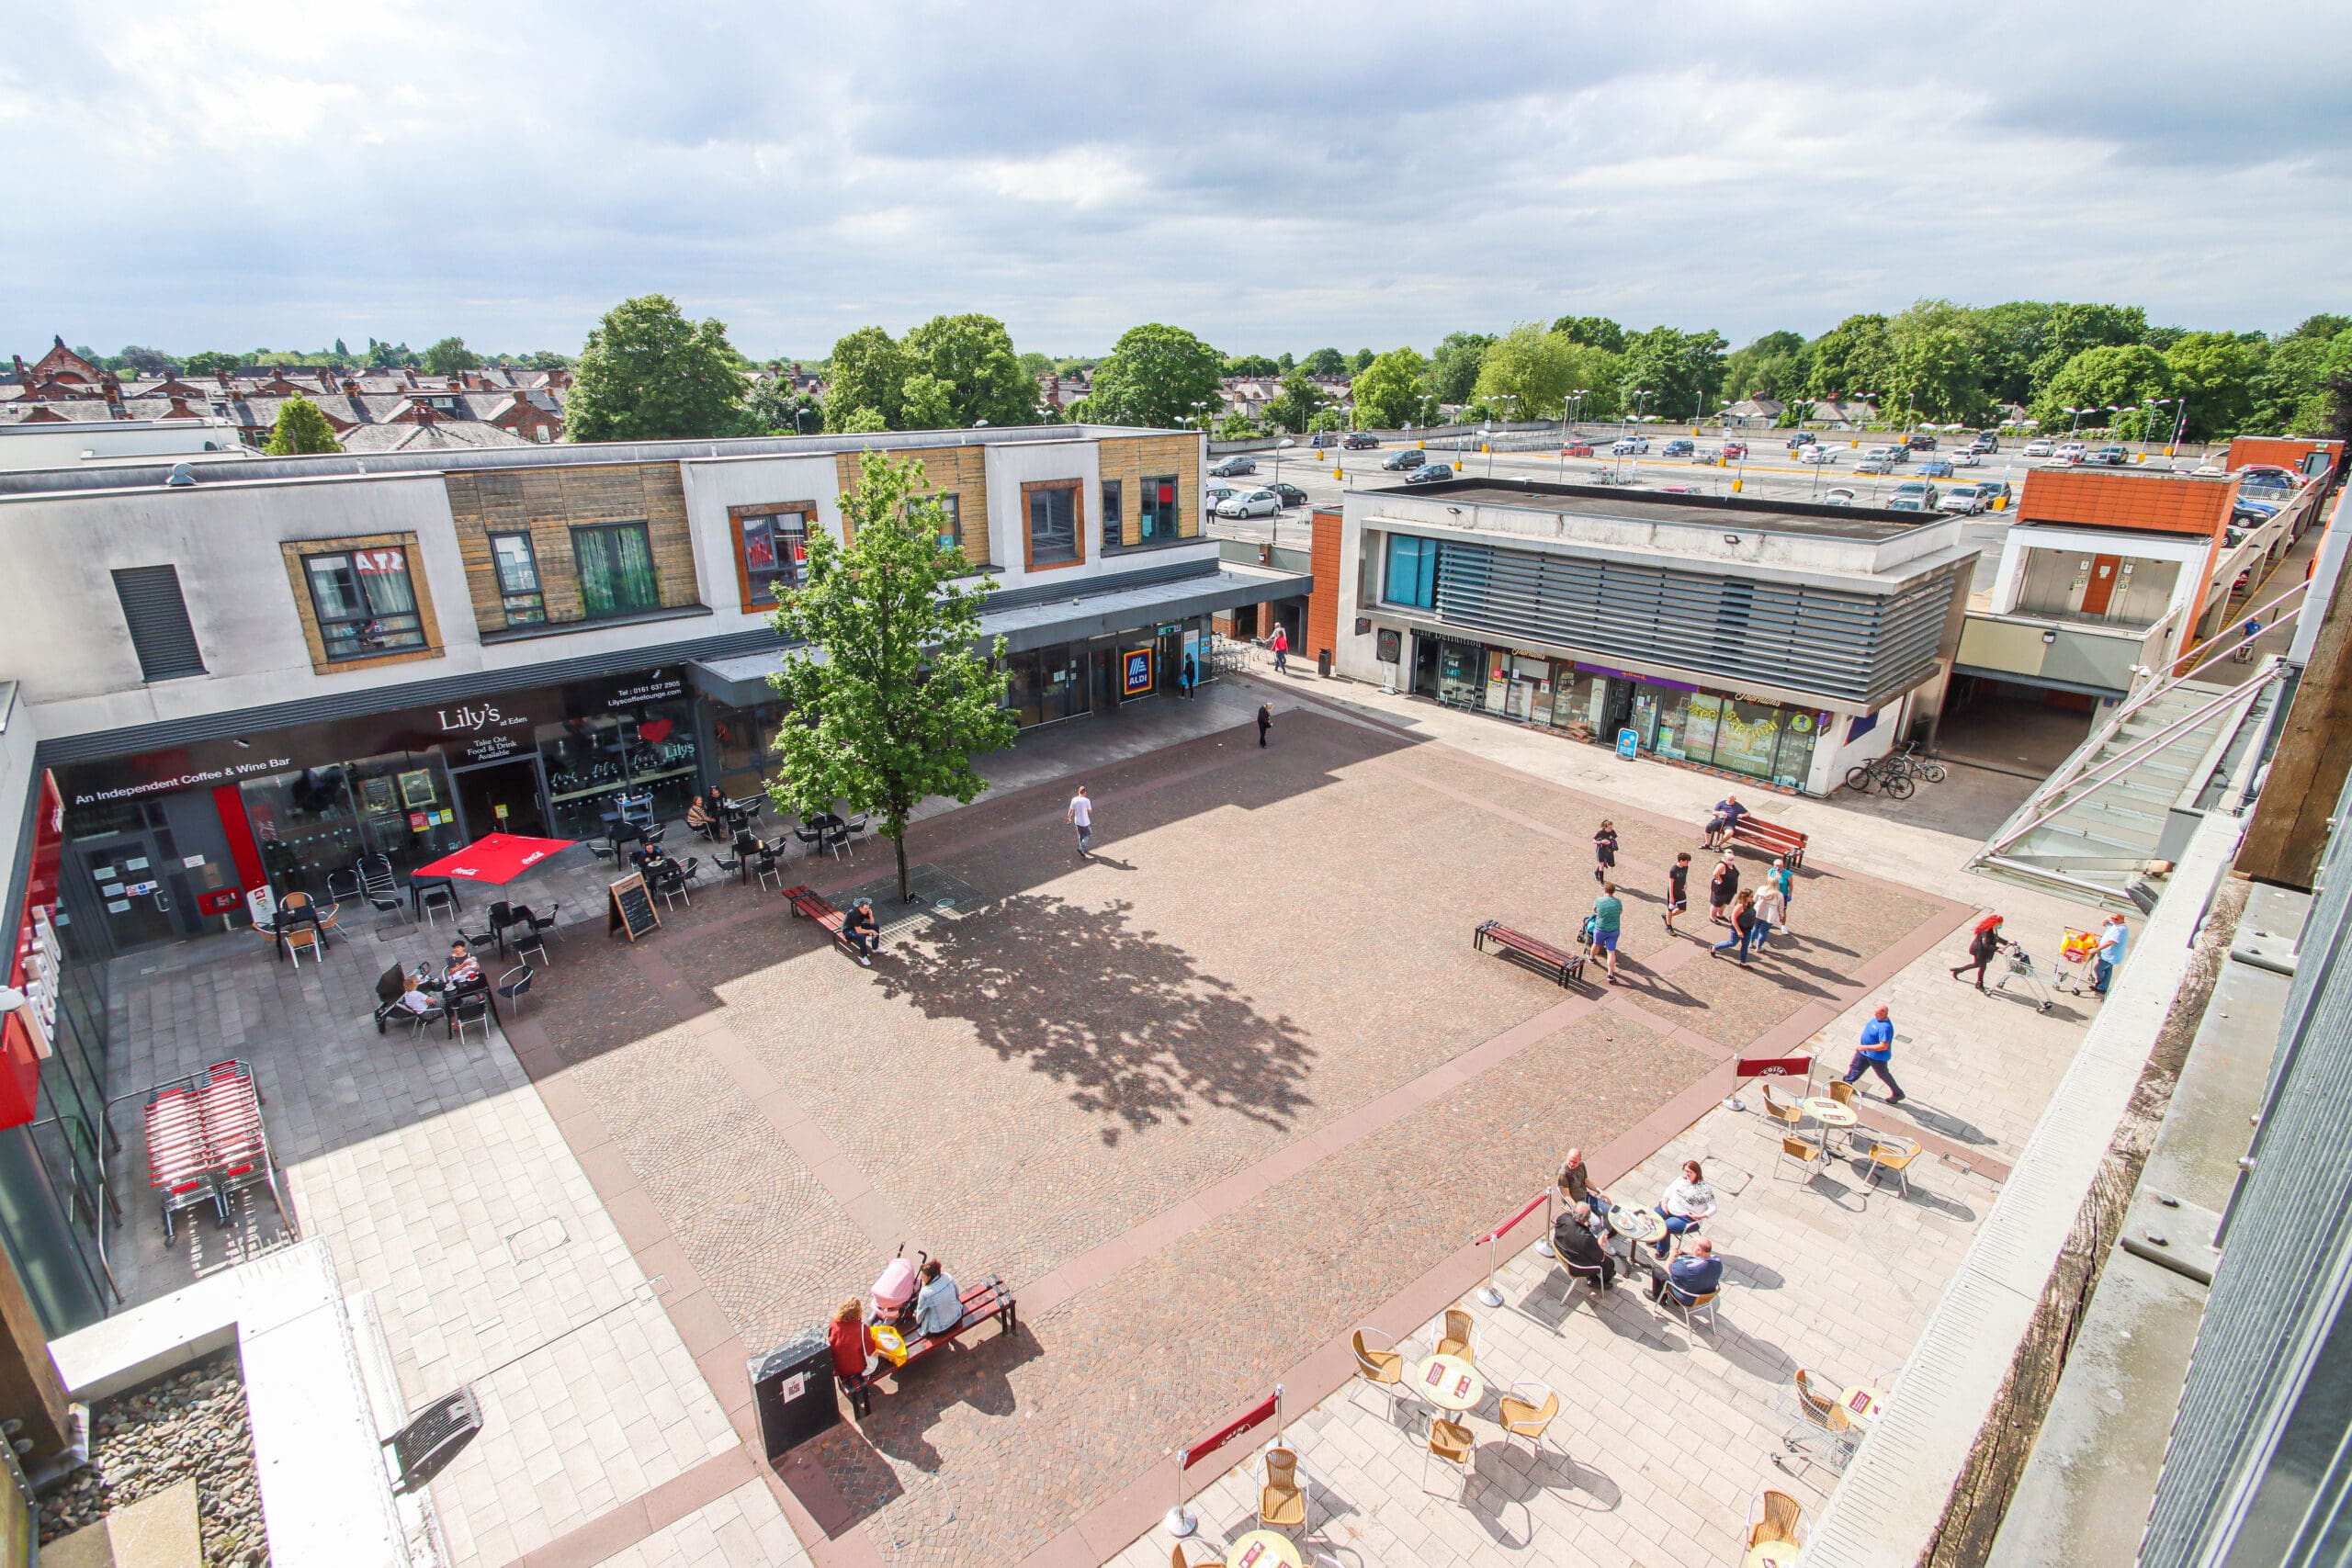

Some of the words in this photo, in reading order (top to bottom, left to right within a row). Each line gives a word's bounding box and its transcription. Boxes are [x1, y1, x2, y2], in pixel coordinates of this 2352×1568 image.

[650, 682, 662, 691] 637
[664, 680, 680, 688] 2905
[1129, 674, 1148, 686] ALDI
[608, 689, 681, 706] Lilyscoffeelounge.com
[1735, 693, 1781, 707] Thorntons
[437, 703, 501, 730] Lily's
[508, 716, 528, 726] Eden
[467, 747, 486, 756] Food
[497, 740, 517, 750] Drink
[474, 739, 492, 747] Take
[478, 750, 510, 761] Available
[75, 795, 95, 805] An
[96, 778, 178, 799] Independent
[181, 770, 222, 784] Coffee
[225, 767, 234, 776] &
[236, 761, 267, 773] Wine
[269, 757, 291, 768] Bar
[1763, 1066, 1784, 1075] COSTA
